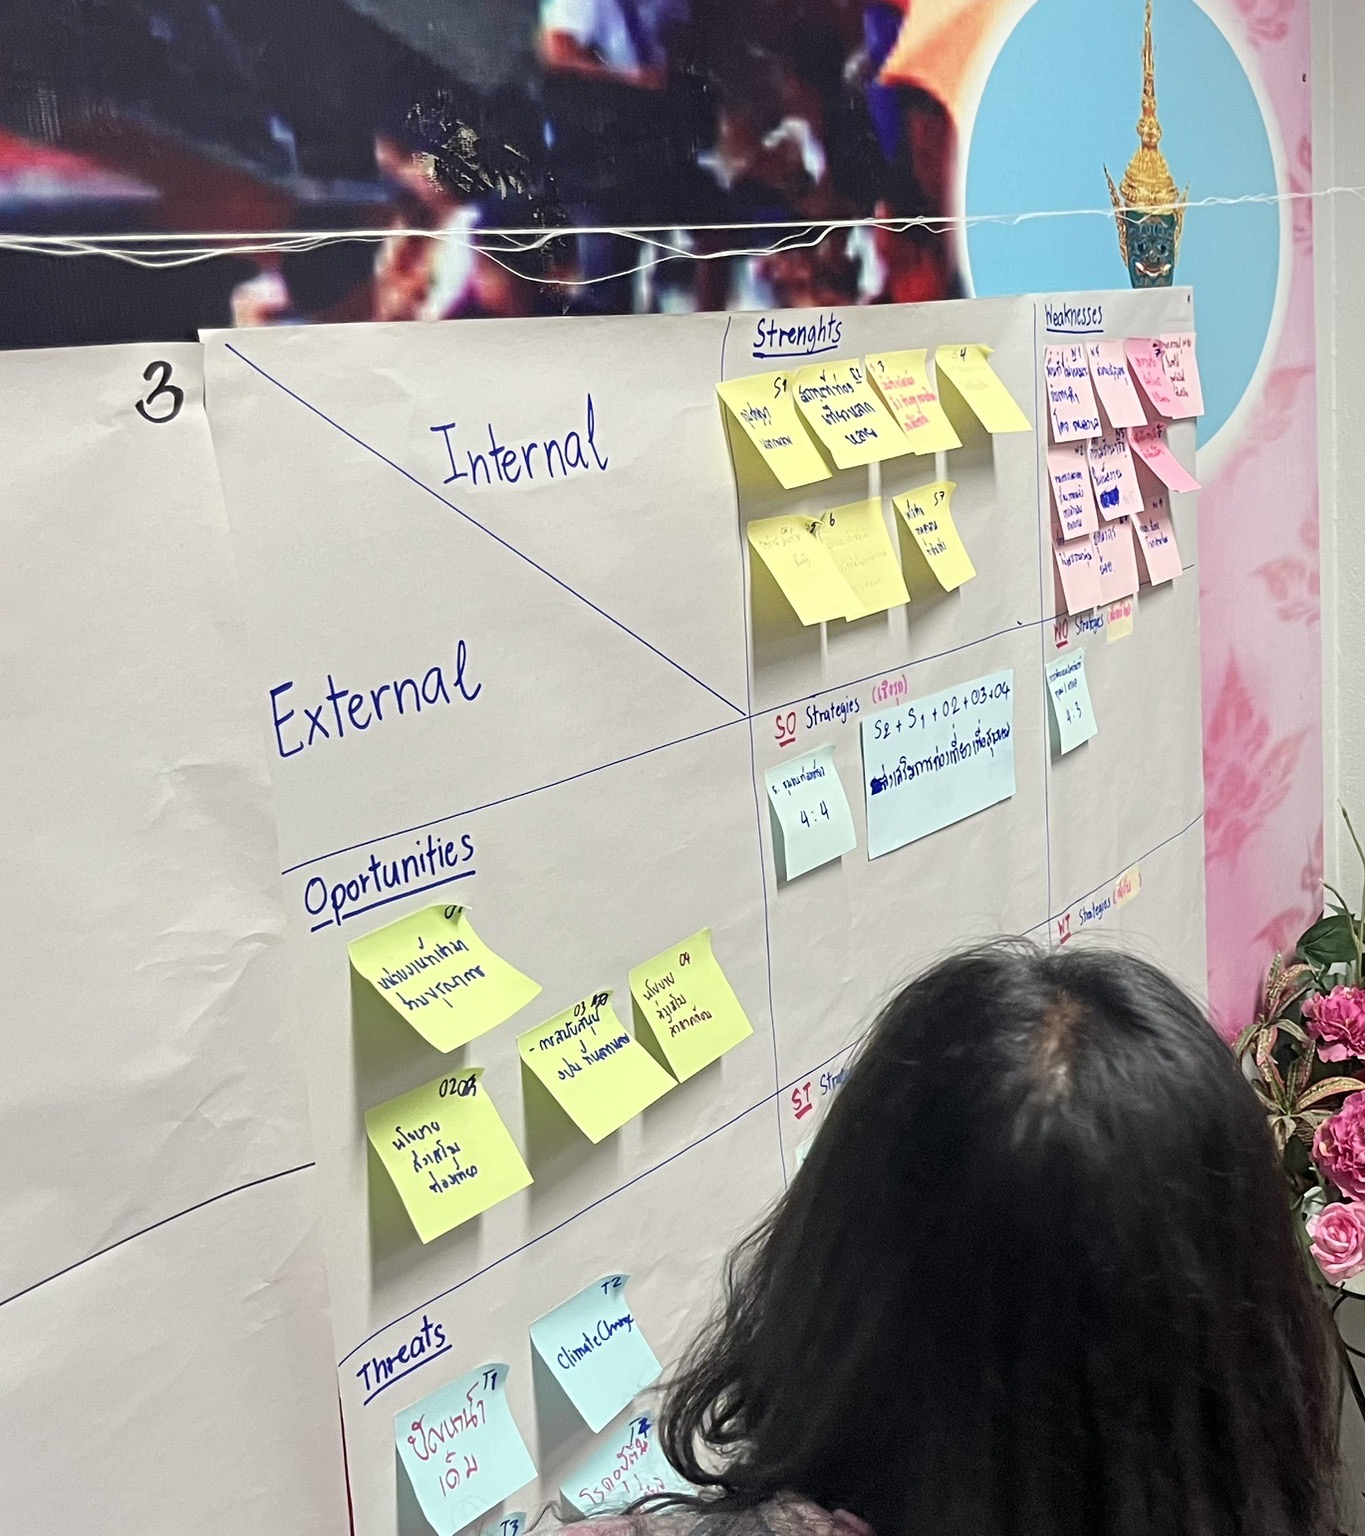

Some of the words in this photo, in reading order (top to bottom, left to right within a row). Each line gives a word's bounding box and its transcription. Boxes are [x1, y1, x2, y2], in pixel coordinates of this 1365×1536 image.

[753, 312, 842, 354] Strenghts
[1045, 303, 1103, 327] Weaknesses
[135, 361, 184, 423] 3
[430, 392, 609, 485] Internal
[269, 639, 482, 758] External
[775, 711, 796, 739] SO
[806, 697, 860, 729] Strategies
[304, 833, 475, 925] Oportunities
[356, 1315, 446, 1391] Threats
